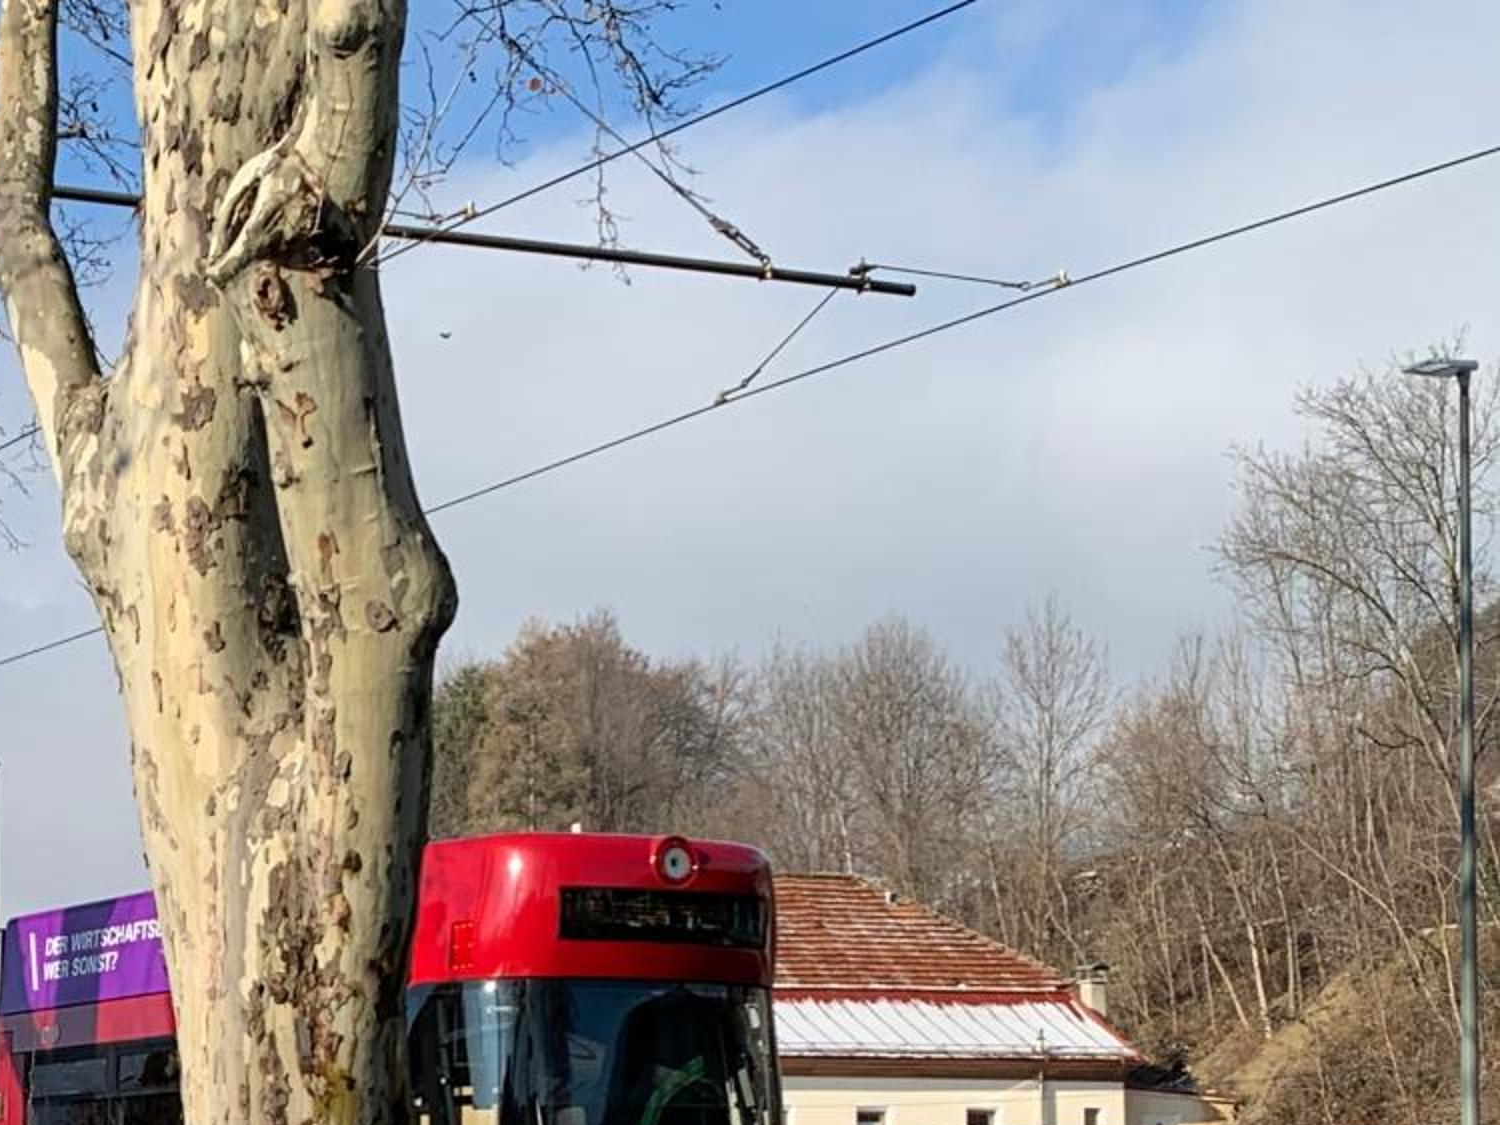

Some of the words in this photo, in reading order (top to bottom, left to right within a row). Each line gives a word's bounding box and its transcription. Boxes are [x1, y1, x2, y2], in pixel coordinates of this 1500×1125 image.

[44, 935, 69, 957] DER
[71, 918, 164, 952] WIRTSCHAFTS
[43, 959, 69, 981] WER
[71, 951, 119, 977] SONST?
